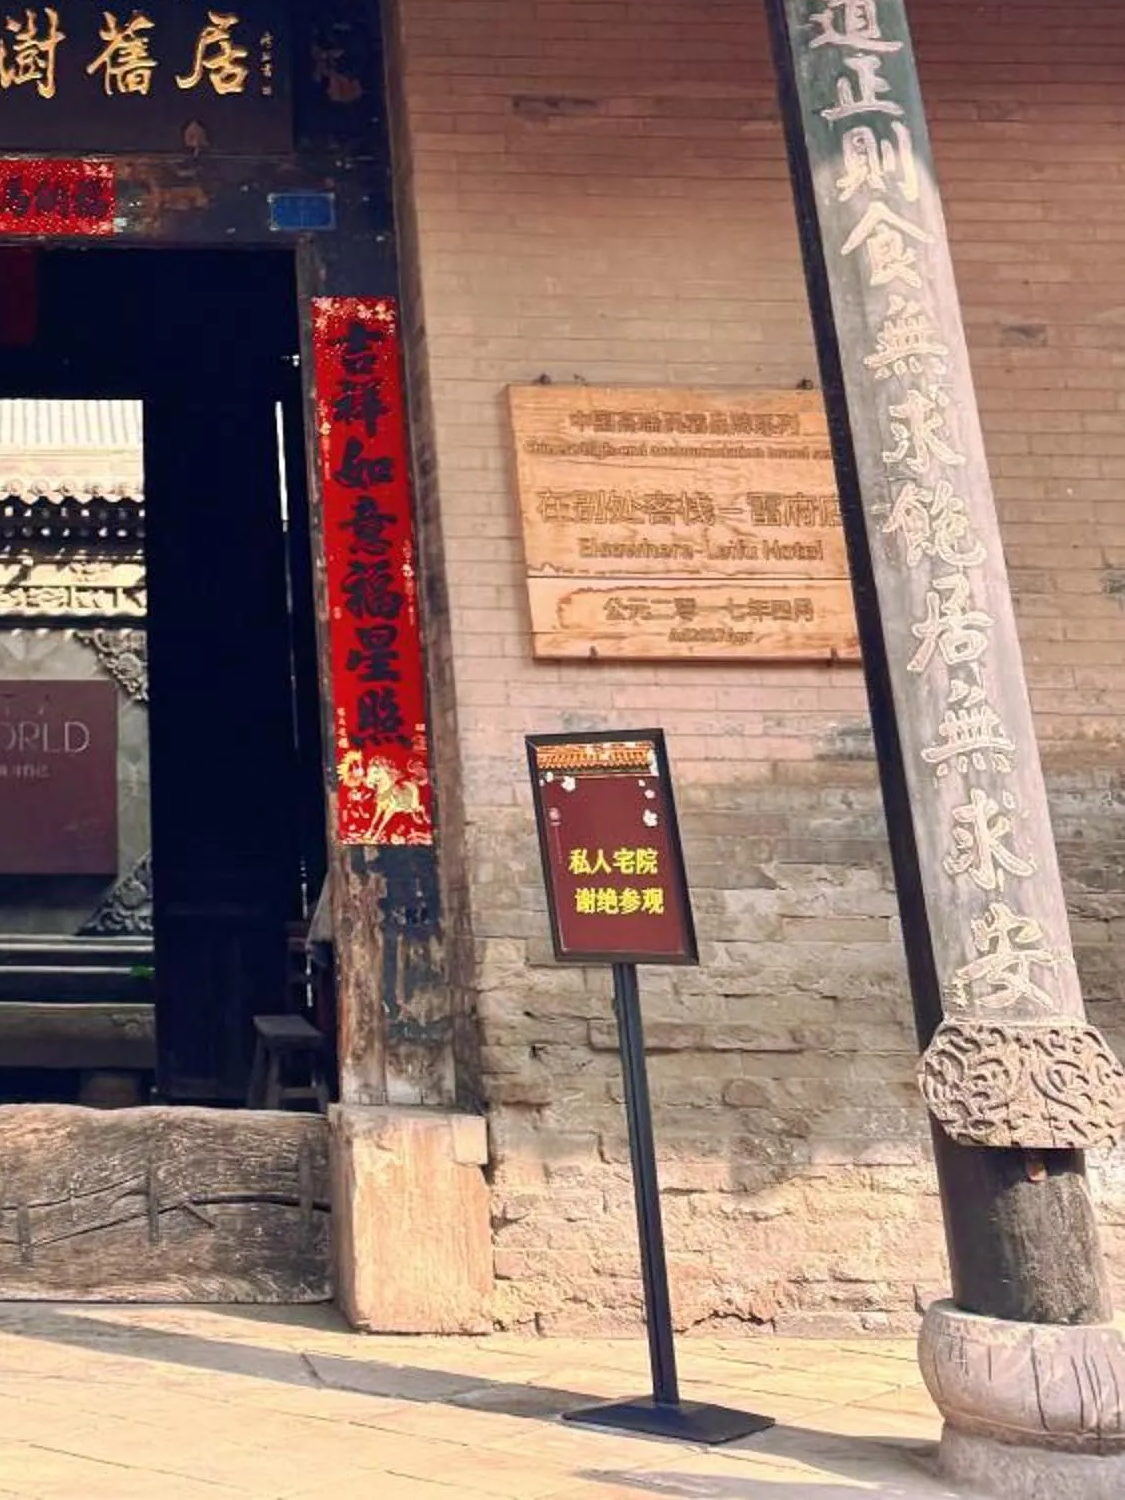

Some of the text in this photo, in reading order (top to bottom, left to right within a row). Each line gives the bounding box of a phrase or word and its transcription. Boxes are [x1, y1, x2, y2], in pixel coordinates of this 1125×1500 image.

[762, 538, 824, 562] Hotel
[568, 846, 658, 875] 私人宅院
[575, 886, 665, 915] 谢绝参观
